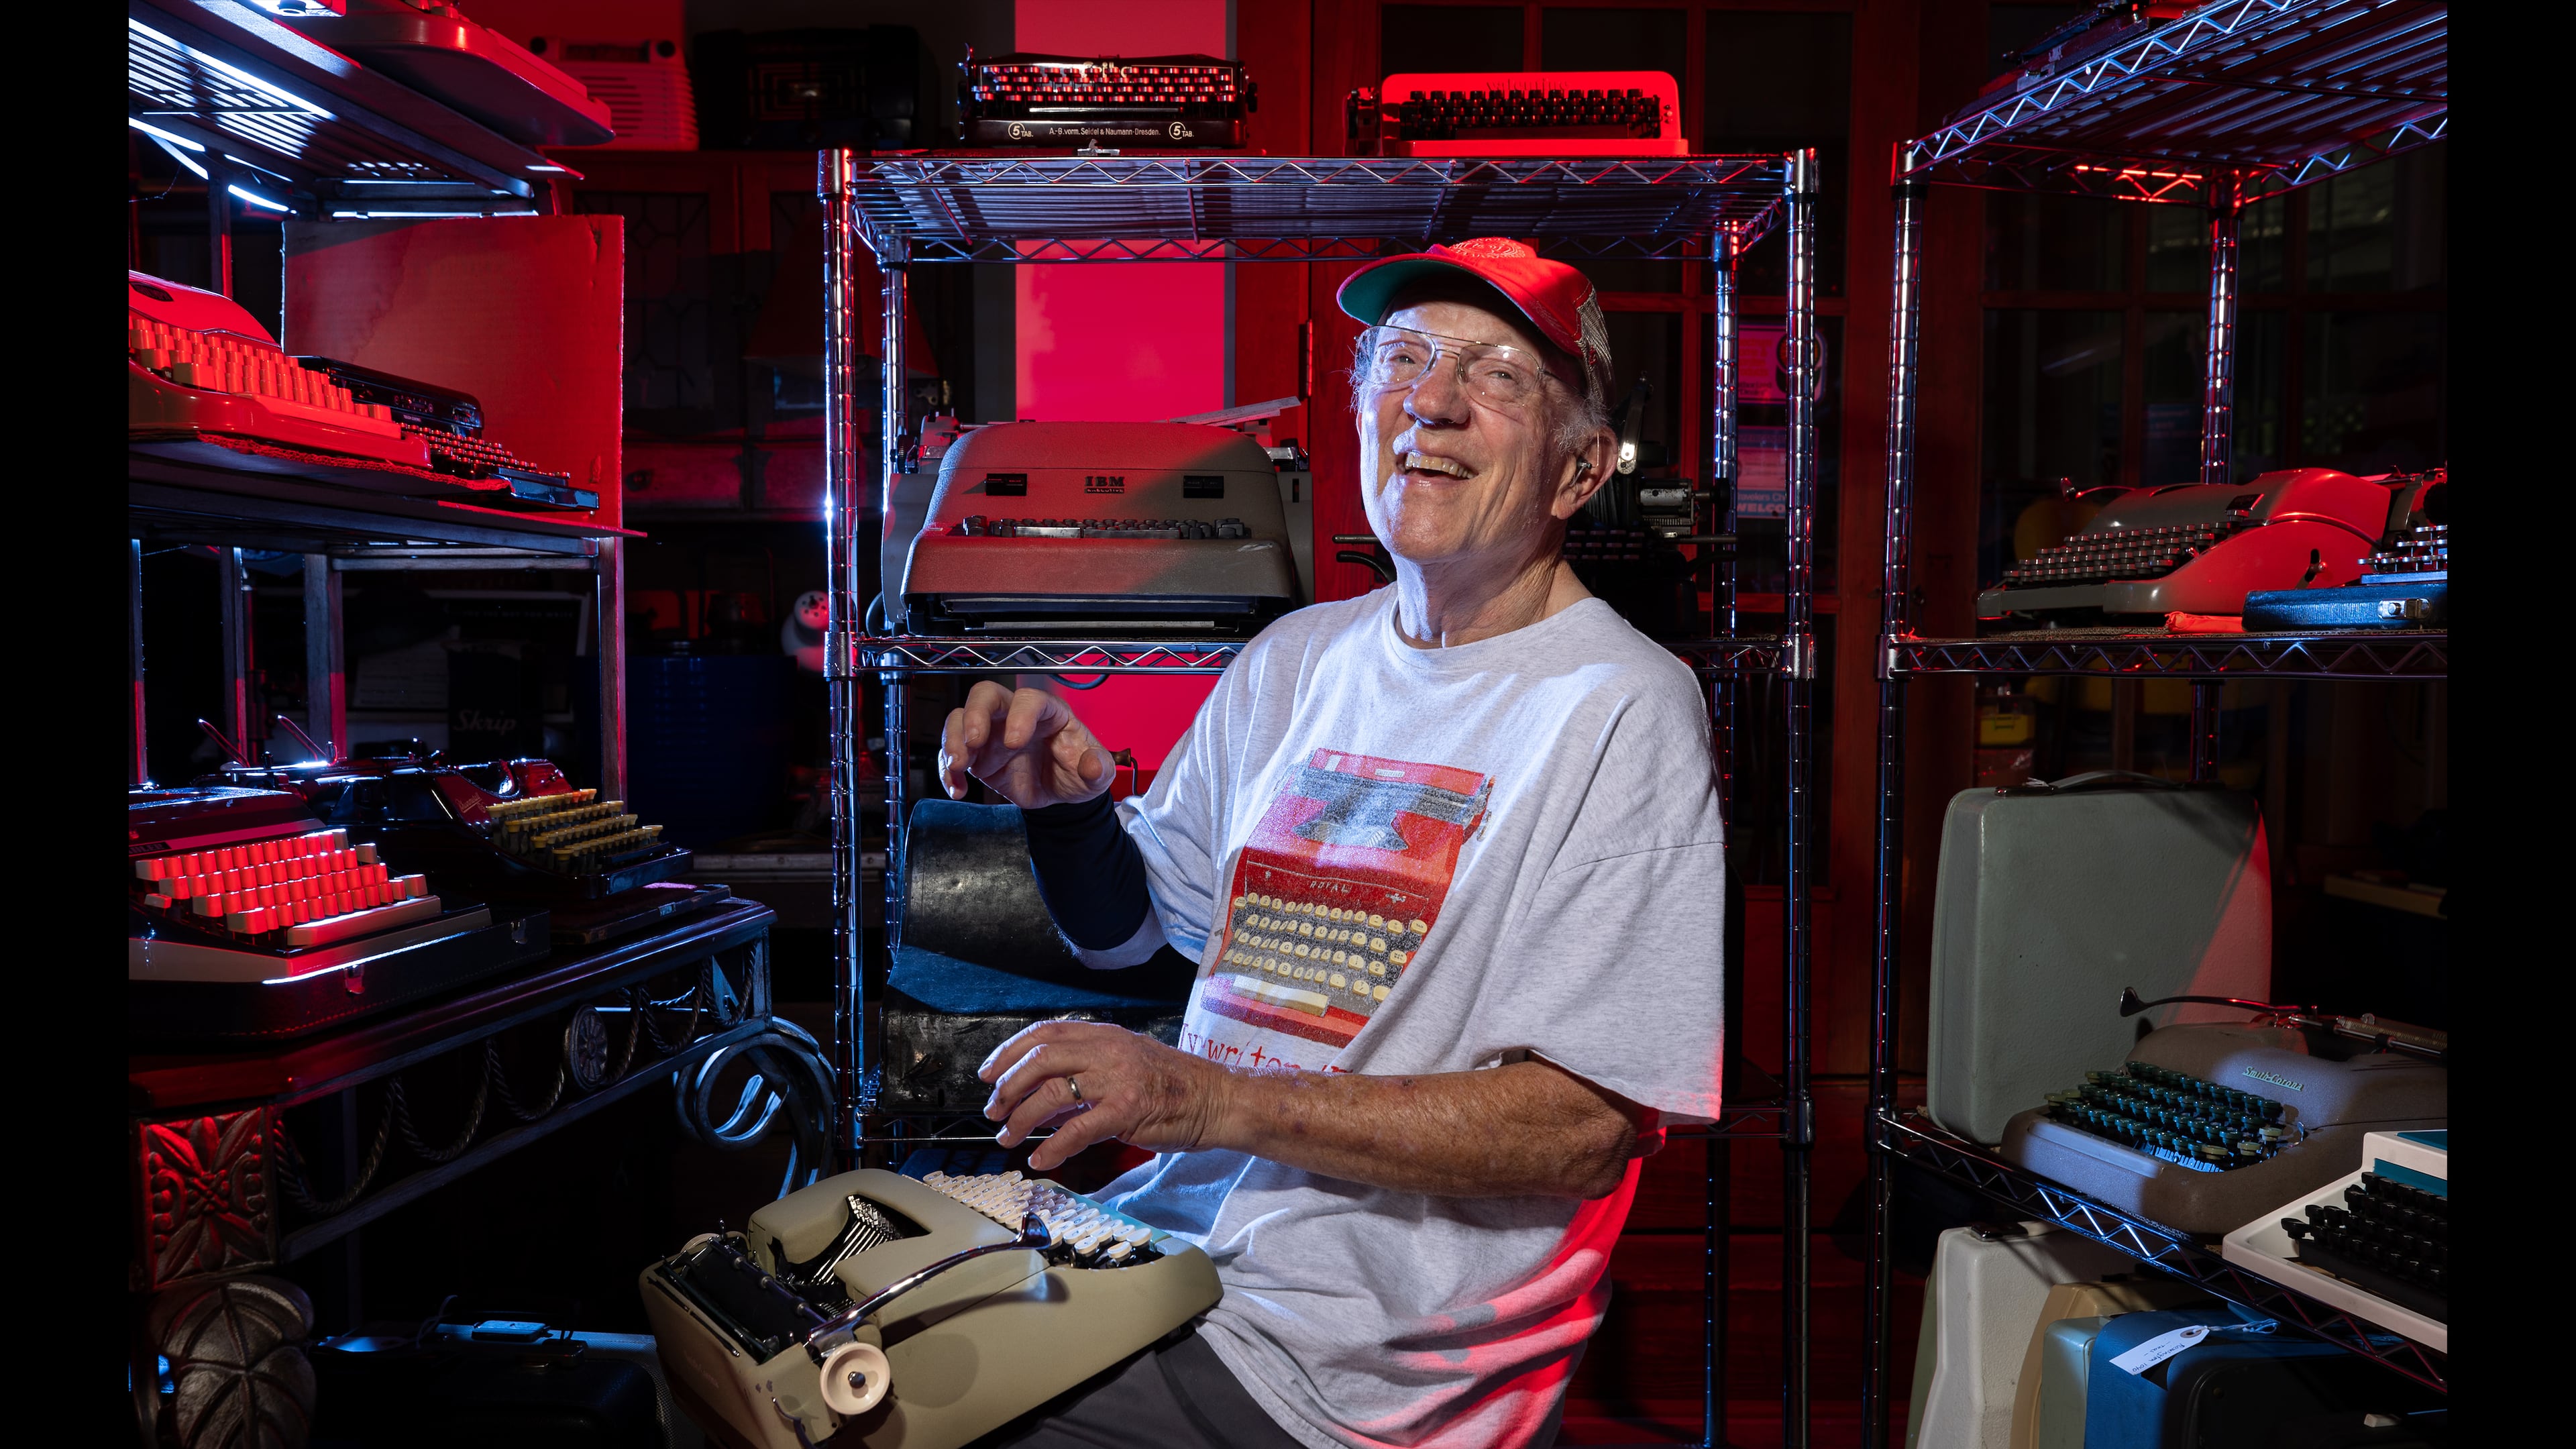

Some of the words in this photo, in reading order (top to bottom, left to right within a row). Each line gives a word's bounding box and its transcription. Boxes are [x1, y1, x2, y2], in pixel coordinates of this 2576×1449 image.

[1081, 127, 1099, 136] Seidel
[1099, 127, 1105, 136] &
[1084, 476, 1125, 487] IBM
[451, 708, 518, 735] Skrip
[1309, 880, 1350, 894] ROYAL
[2242, 1066, 2304, 1091] Smith-Corona
[2132, 1362, 2148, 1373] 1040
